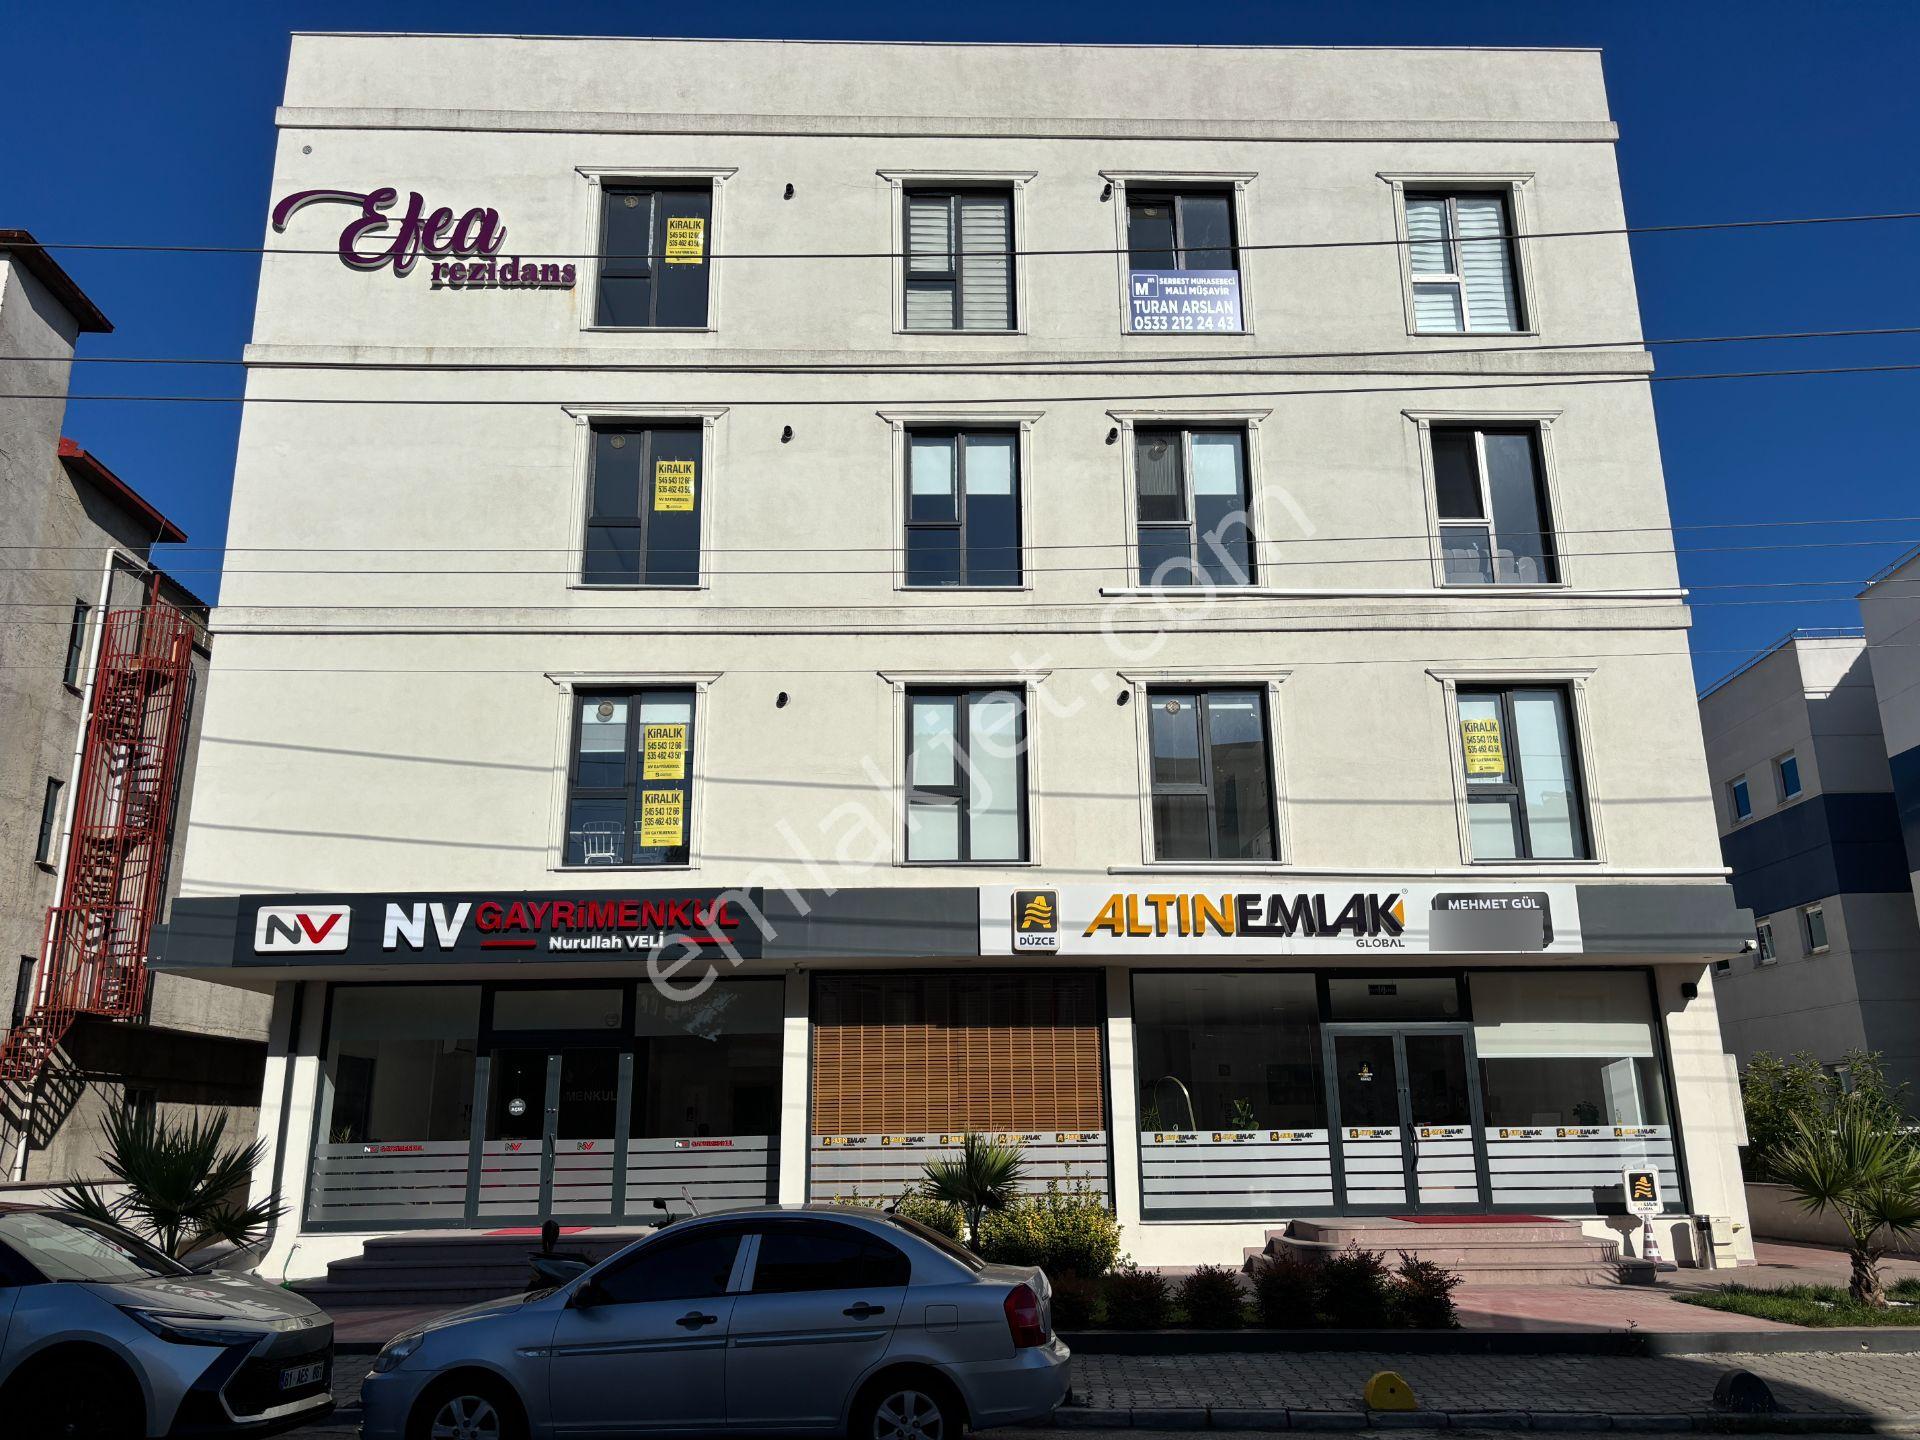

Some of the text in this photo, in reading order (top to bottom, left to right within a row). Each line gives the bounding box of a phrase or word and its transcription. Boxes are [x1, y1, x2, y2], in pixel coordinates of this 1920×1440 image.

[431, 258, 576, 287] rezidans
[1134, 300, 1233, 314] TURAN ARSLAN
[1134, 316, 1234, 330] 0533 212 24 43
[1448, 896, 1540, 910] MEHMET GÜL
[265, 914, 343, 944] NV
[383, 902, 472, 948] NV
[549, 934, 622, 950] Nurullah
[1020, 935, 1055, 946] DÜZCE
[1356, 939, 1405, 948] GLOBAL
